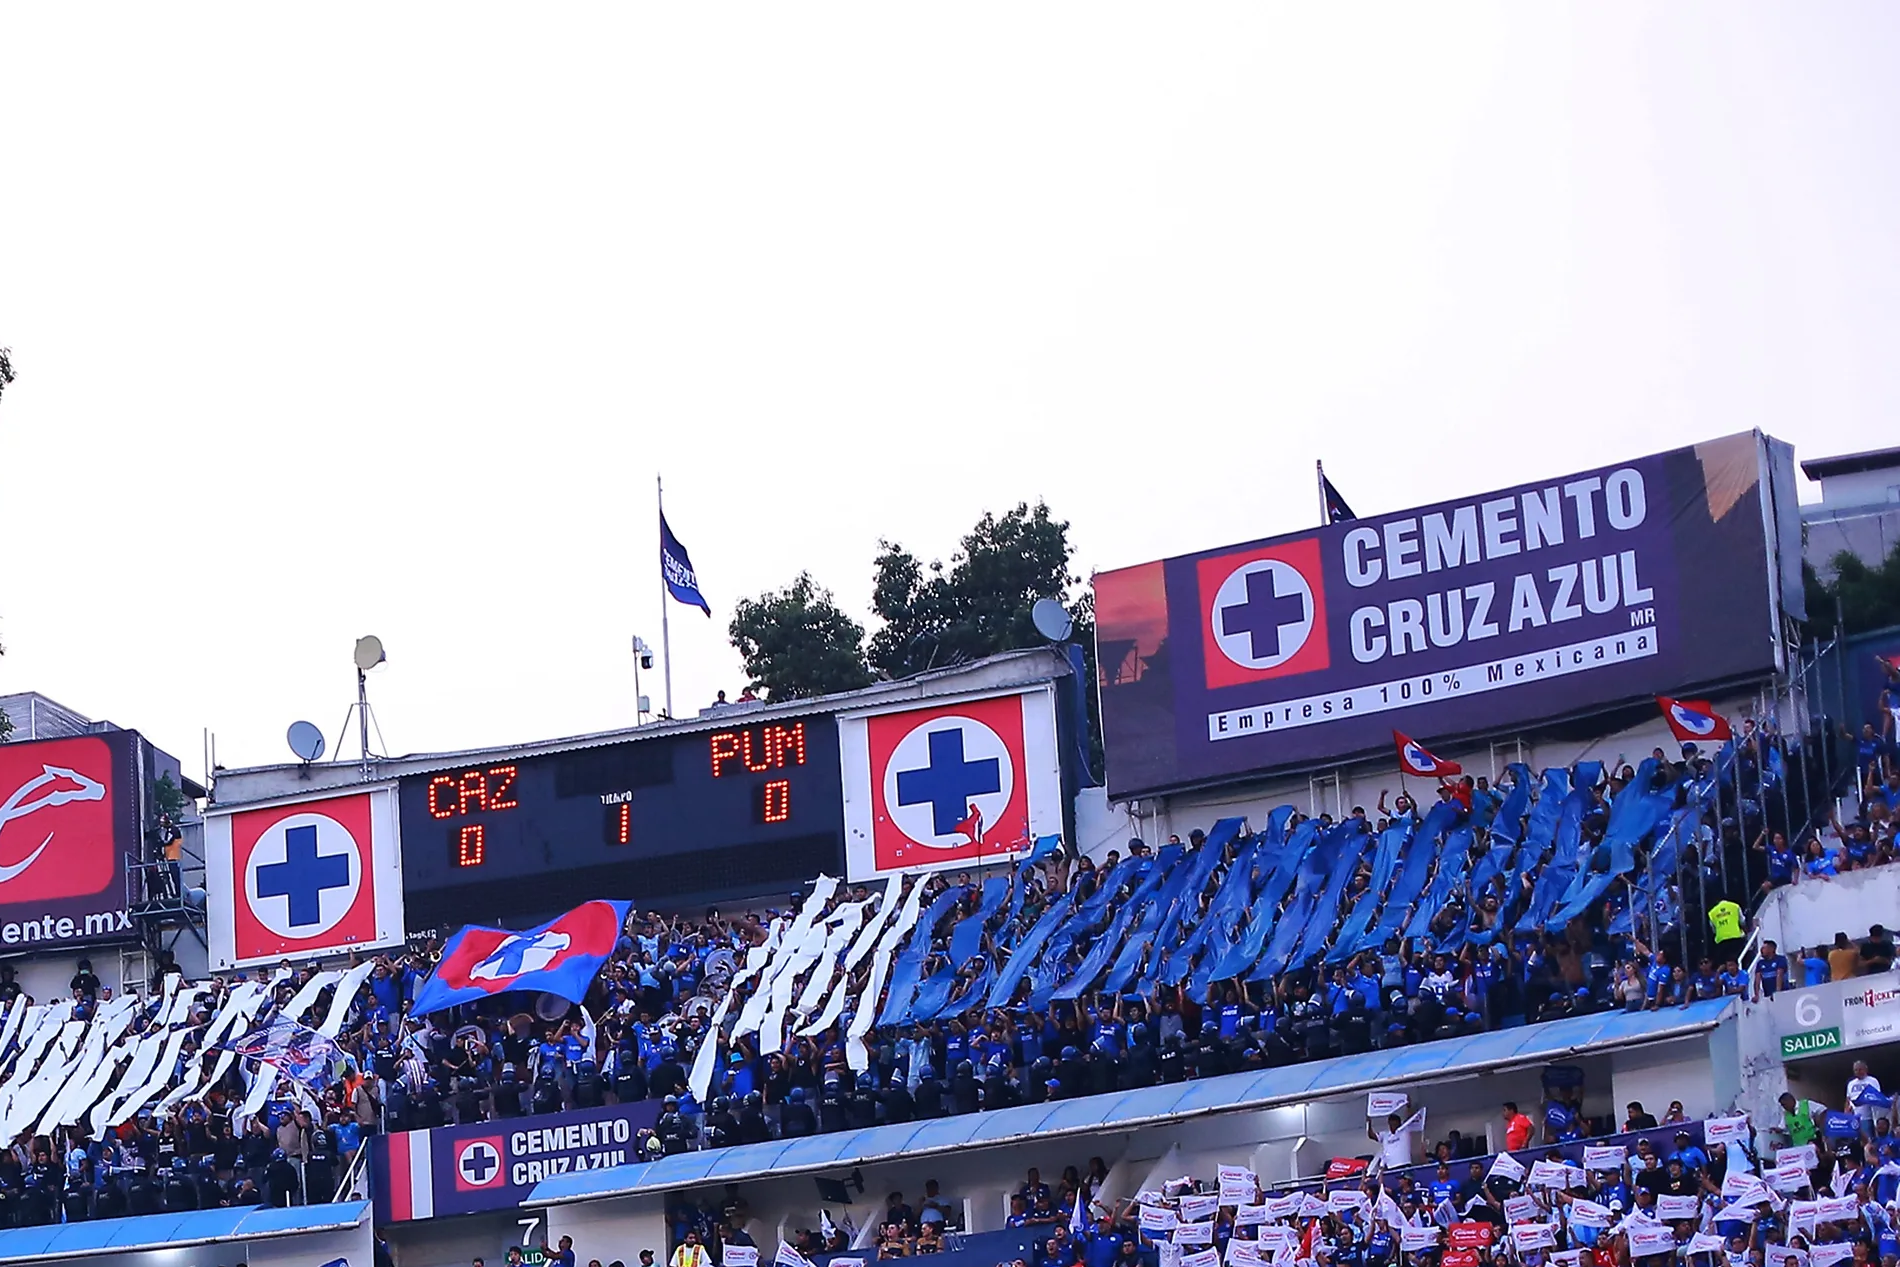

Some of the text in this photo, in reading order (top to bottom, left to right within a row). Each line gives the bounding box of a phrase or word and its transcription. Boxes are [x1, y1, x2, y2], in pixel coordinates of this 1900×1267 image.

[1343, 468, 1647, 588] CEMENTO
[1349, 550, 1655, 664] CRUZ AZUL
[1629, 608, 1656, 627] MR
[1218, 635, 1649, 733] Empresa 100% Mexicana
[710, 722, 806, 778] PUM
[427, 766, 519, 819] CAZ
[763, 779, 790, 823] 0
[618, 802, 631, 844] 1
[459, 824, 485, 867] 0
[1795, 993, 1822, 1027] 6
[1784, 1031, 1837, 1053] SALIDA
[510, 1118, 630, 1157] CEMENTO
[517, 1216, 541, 1247] 7
